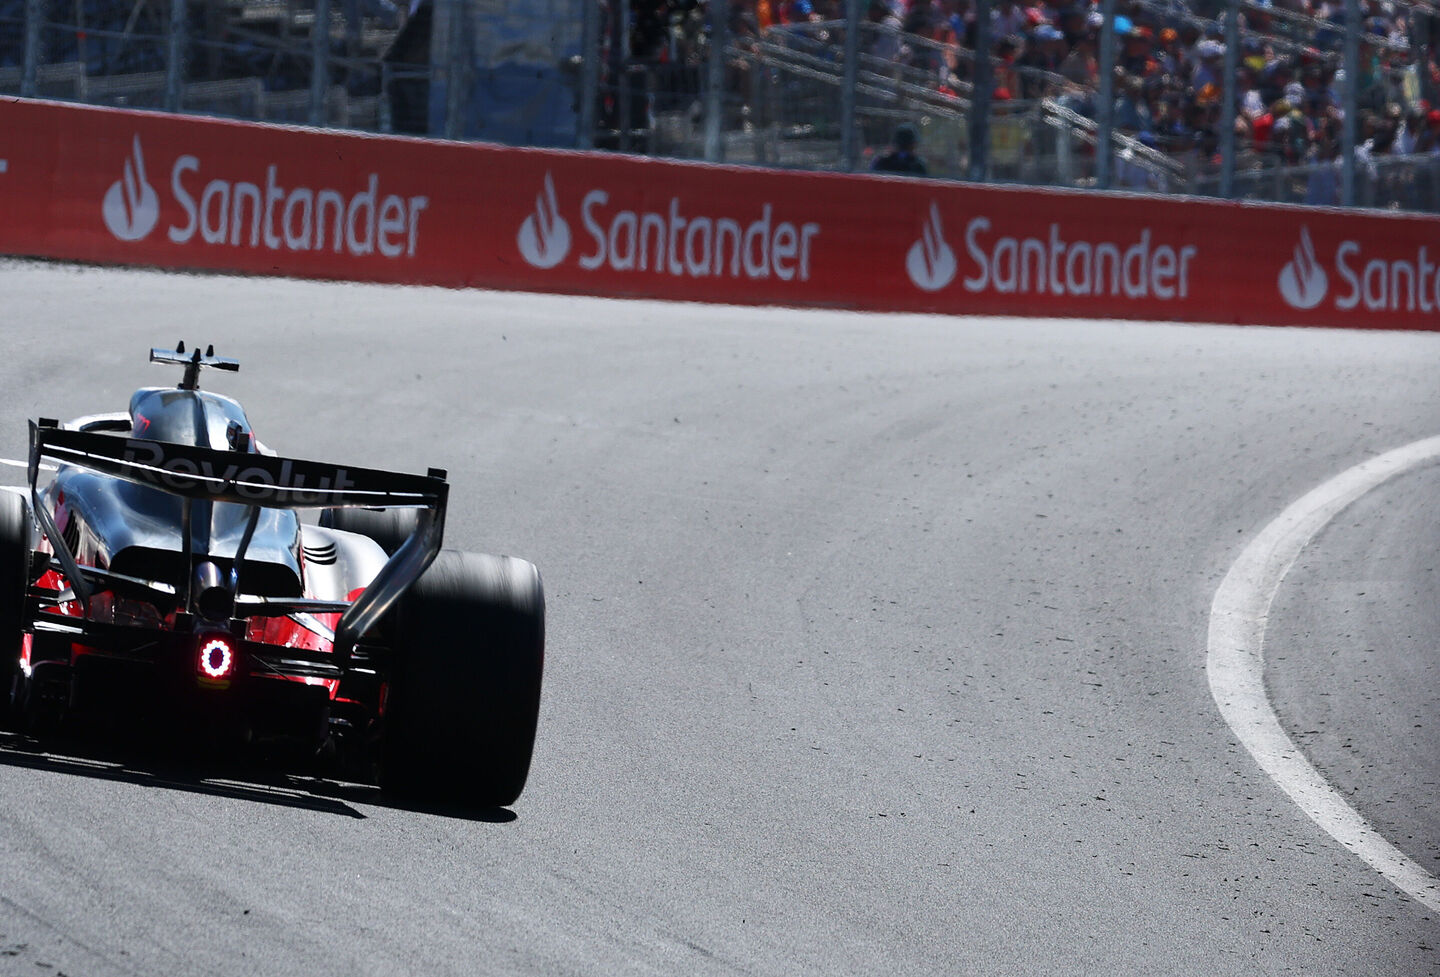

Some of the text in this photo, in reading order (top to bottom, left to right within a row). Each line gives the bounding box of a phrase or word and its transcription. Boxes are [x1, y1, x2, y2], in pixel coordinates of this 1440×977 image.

[168, 155, 428, 257] Santander
[580, 190, 819, 280] Santander
[965, 218, 1196, 298] Santander
[1336, 241, 1440, 312] Sant
[120, 440, 357, 506] Revolut
